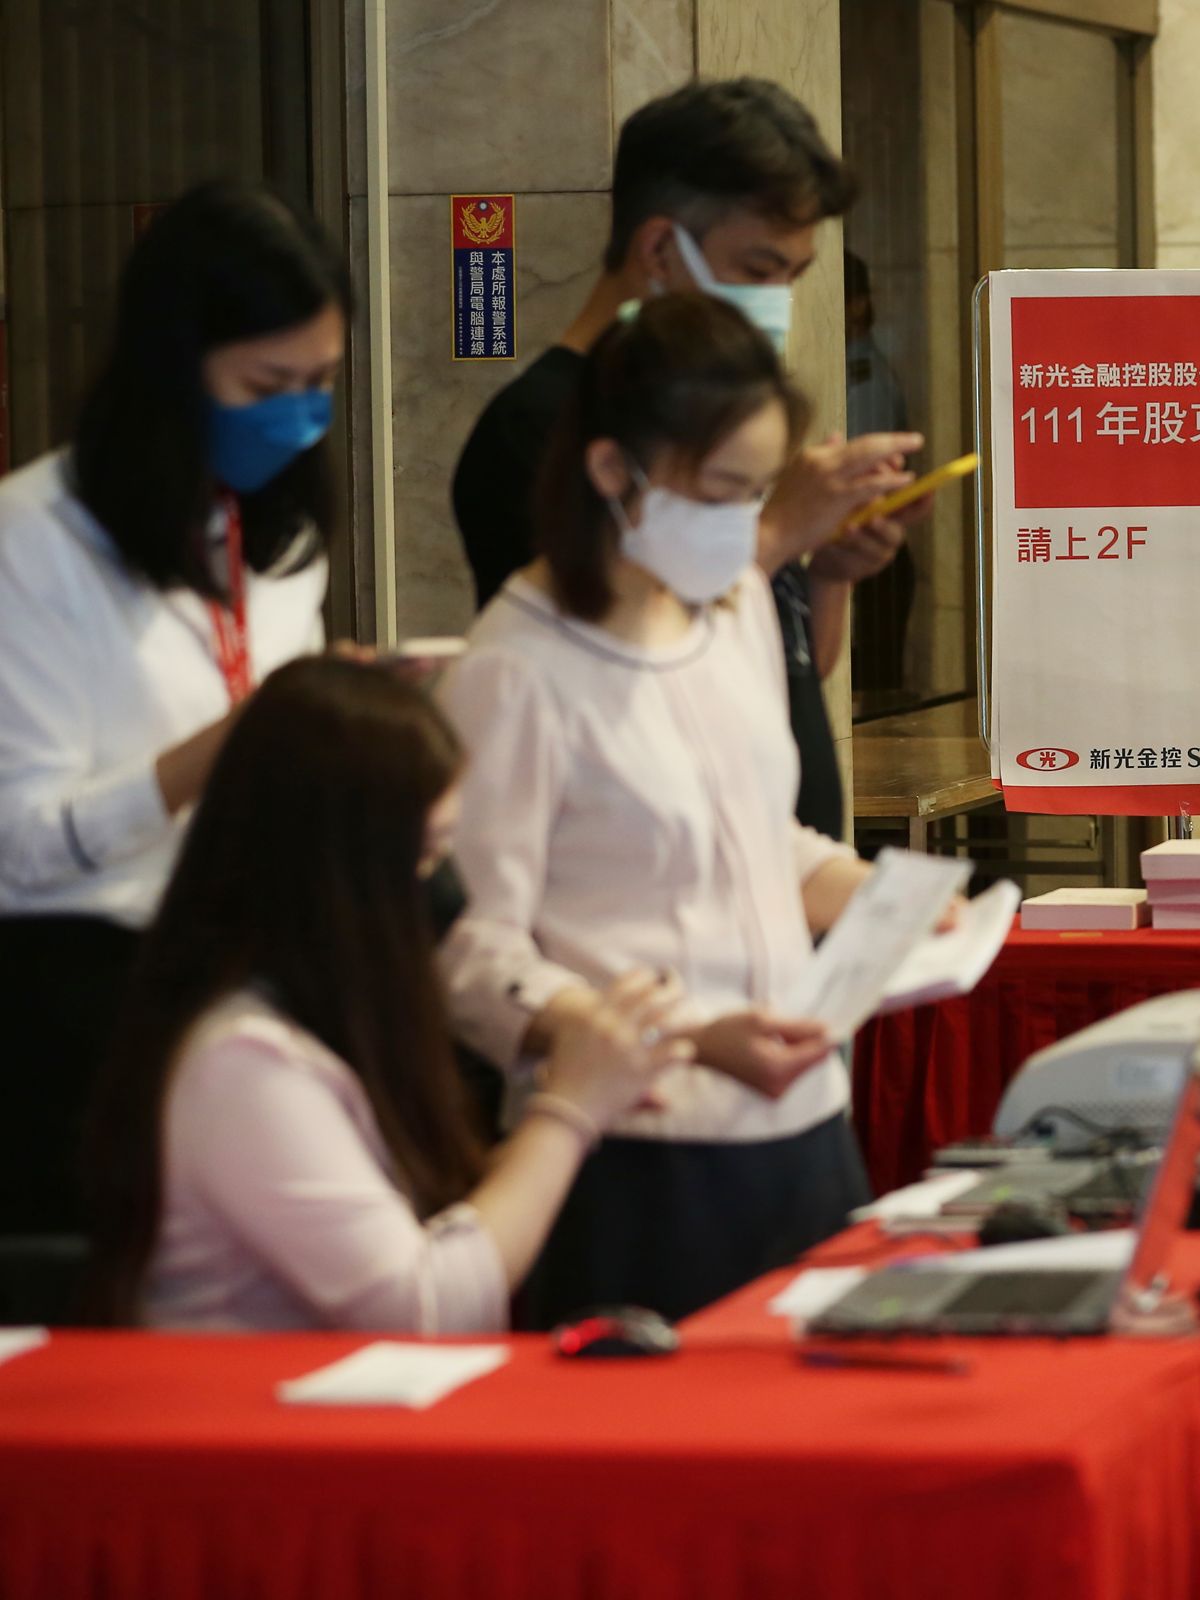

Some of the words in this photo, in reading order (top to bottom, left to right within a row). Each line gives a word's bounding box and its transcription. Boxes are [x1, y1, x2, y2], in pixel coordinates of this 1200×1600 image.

[469, 250, 485, 355] 與警局電腦連線
[491, 250, 507, 355] 本處所報警系統
[1017, 526, 1148, 562] 請上2F
